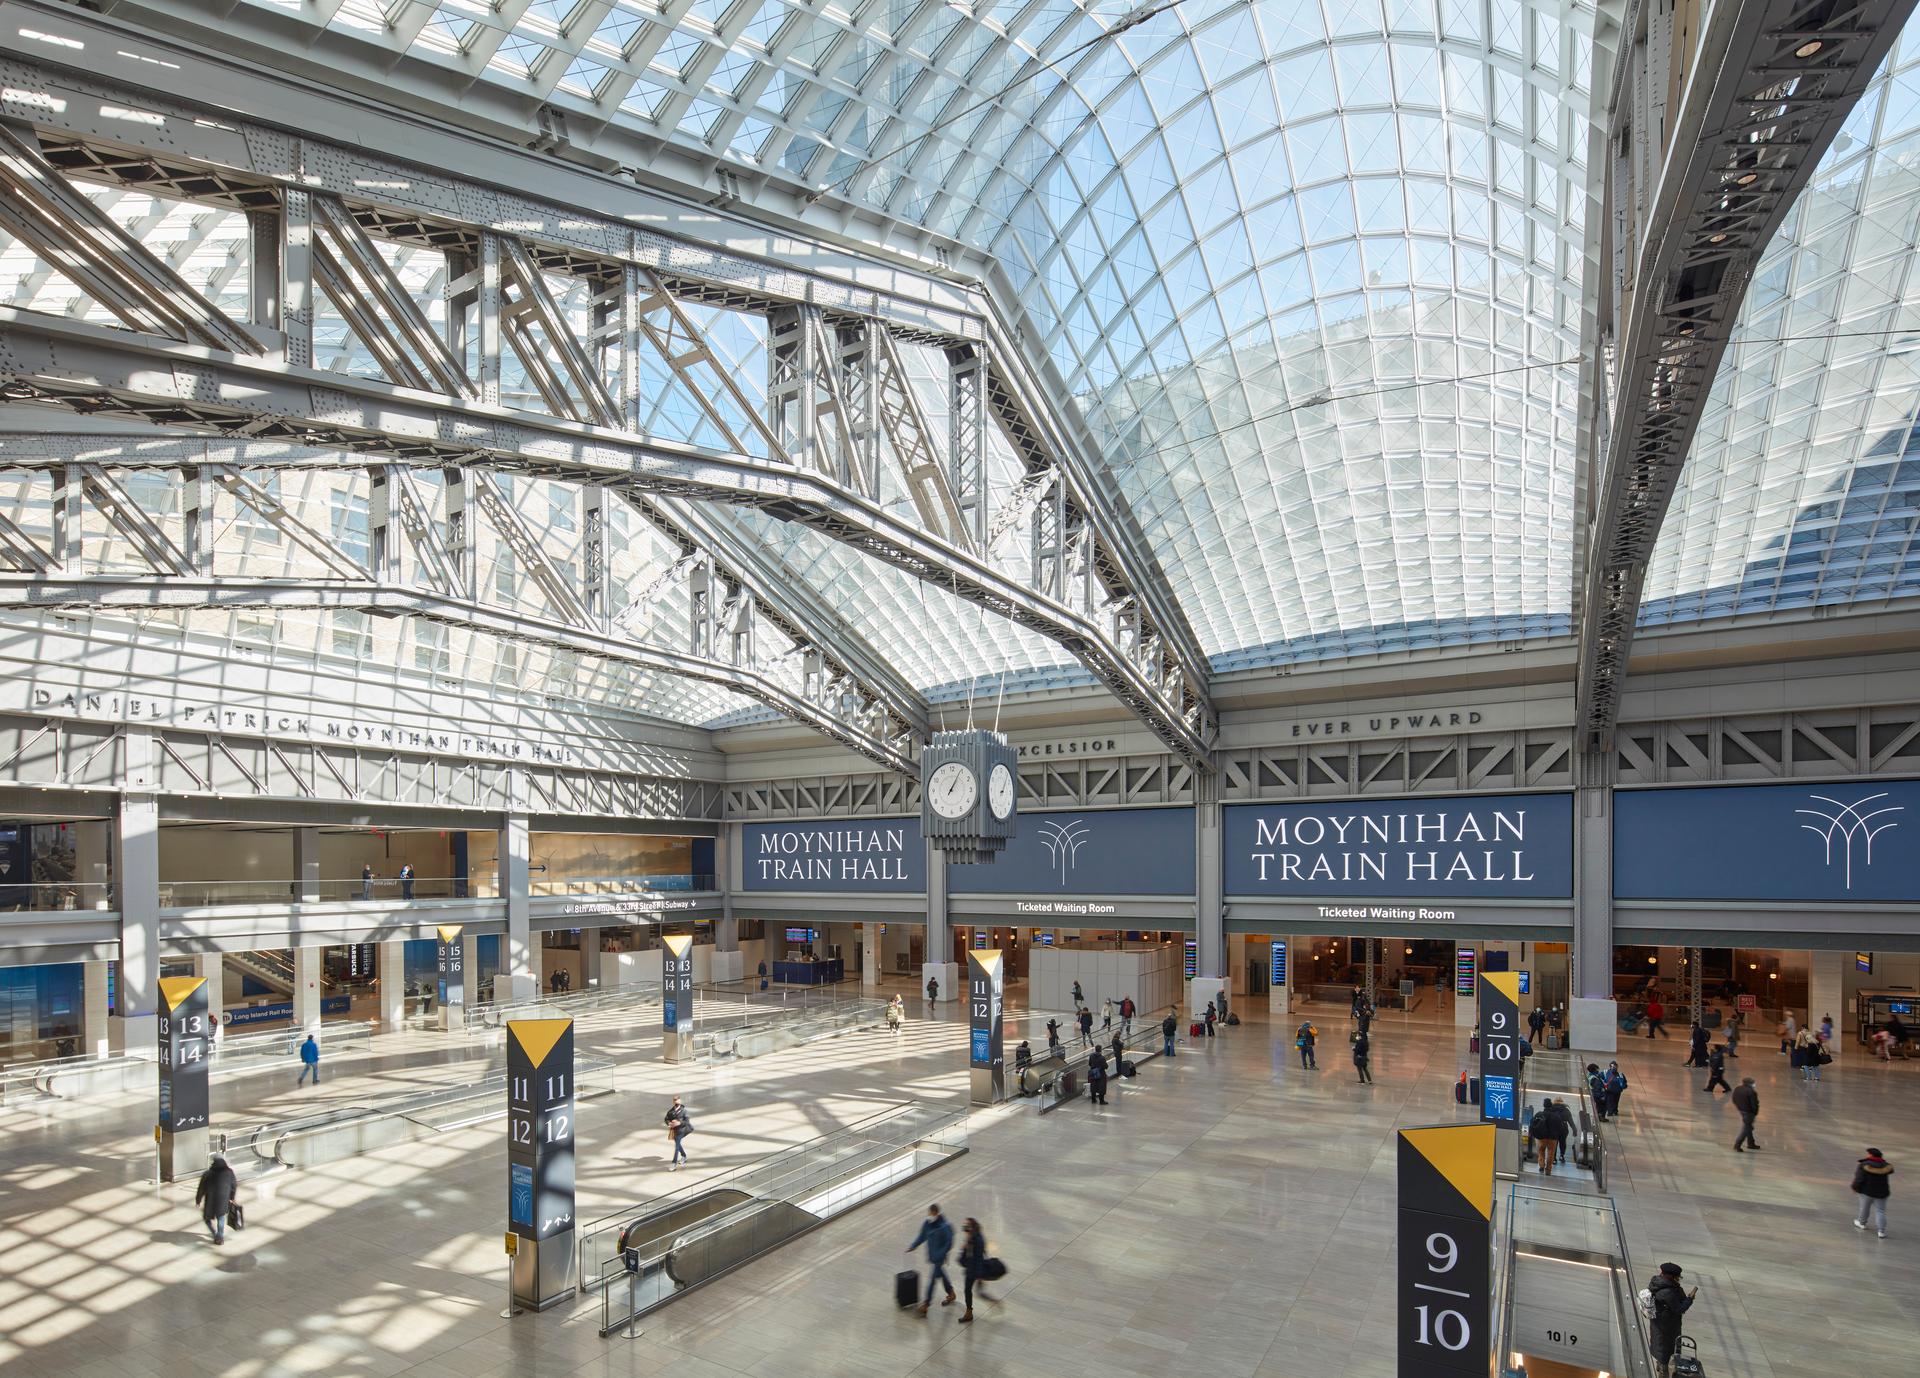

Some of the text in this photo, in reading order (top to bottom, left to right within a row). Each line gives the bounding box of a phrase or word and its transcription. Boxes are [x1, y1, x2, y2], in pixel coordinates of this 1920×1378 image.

[34, 689, 572, 762] DANIEL PATRICK MOYNIHAN TRAIN HALL
[1292, 712, 1482, 737] EVER UPWARD
[1018, 740, 1115, 756] XCELSIOR
[1255, 811, 1526, 845] MOYNIHAN
[760, 830, 904, 854] MOYNIHAN
[758, 858, 908, 880] TRAIN HALL
[1251, 851, 1535, 881] TRAIN HALL
[665, 900, 688, 909] Subway
[1017, 902, 1115, 913] Ticketed Waiting Room
[1318, 907, 1455, 920] Ticketed Waiting Room
[439, 946, 446, 956] 15
[450, 946, 460, 956] 15
[439, 962, 446, 972] 16
[451, 962, 461, 972] 16
[665, 961, 675, 972] 13
[680, 960, 690, 971] 13
[665, 980, 675, 990] 14
[680, 979, 690, 990] 14
[974, 980, 986, 994] 11
[994, 980, 1001, 994] 11
[974, 1004, 987, 1017] 12
[994, 1002, 1002, 1016] 12
[160, 1017, 169, 1034] 13
[180, 1016, 202, 1034] 13
[1492, 1012, 1506, 1029] 9
[160, 1047, 170, 1064] 14
[179, 1045, 202, 1064] 14
[1488, 1042, 1511, 1060] 10
[514, 1076, 528, 1102] 11
[546, 1074, 566, 1101] 11
[513, 1118, 530, 1145] 12
[545, 1116, 569, 1144] 12
[1426, 1232, 1458, 1273] 9
[1414, 1305, 1470, 1351] 10
